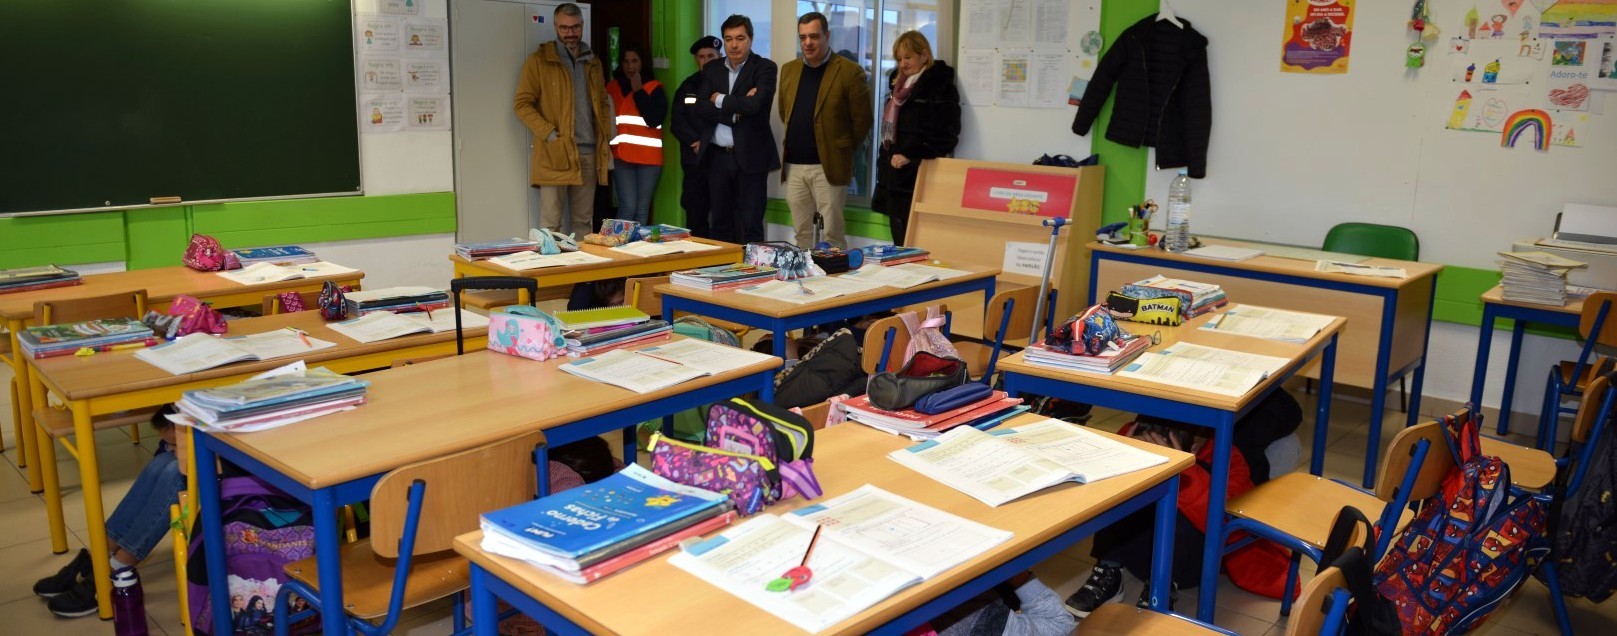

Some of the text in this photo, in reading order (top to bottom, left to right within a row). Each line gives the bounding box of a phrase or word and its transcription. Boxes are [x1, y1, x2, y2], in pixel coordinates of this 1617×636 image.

[1142, 303, 1174, 313] BATMAN
[546, 509, 601, 531] Caderno
[564, 503, 610, 521] Fichas
